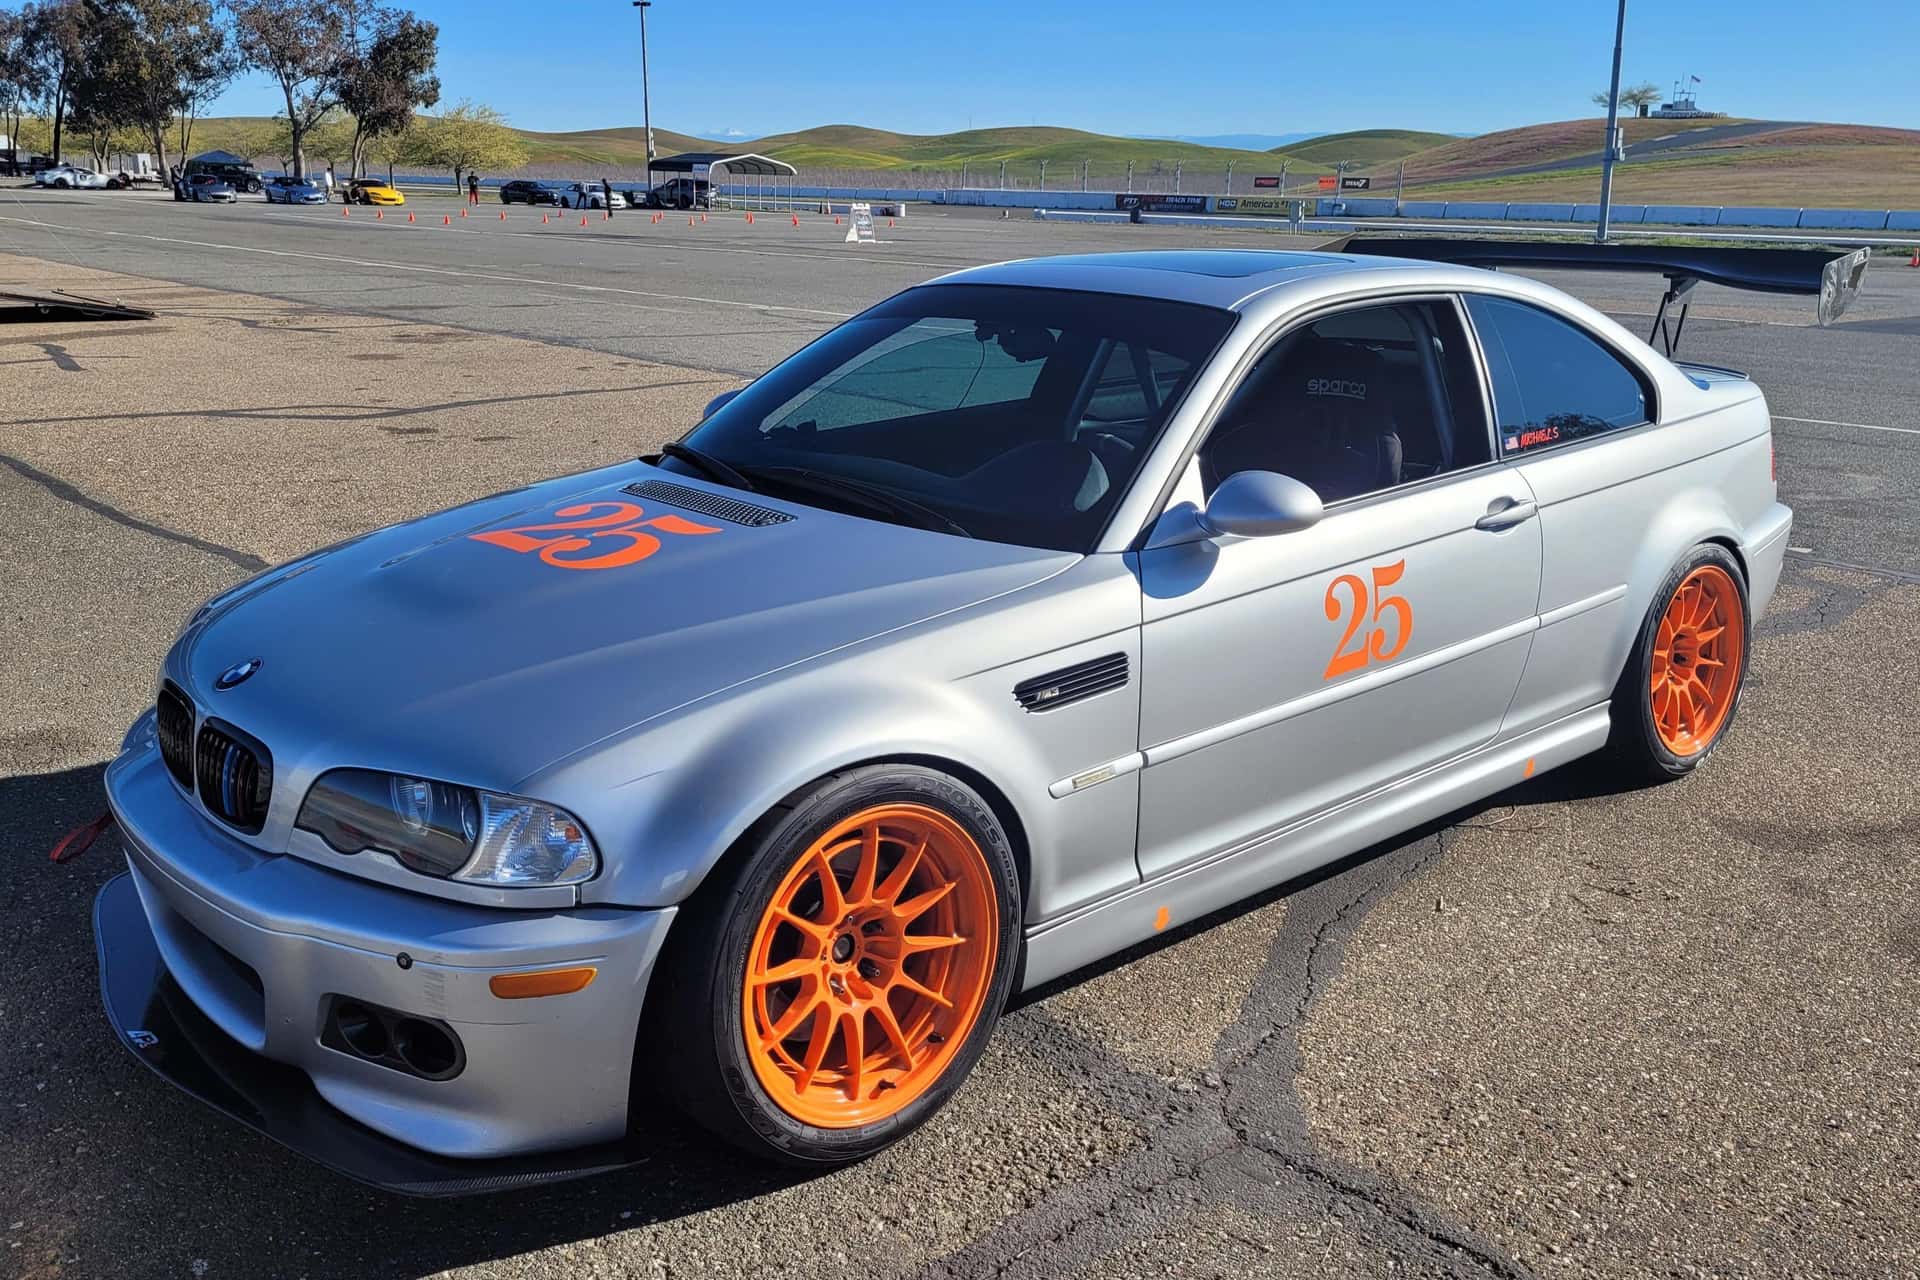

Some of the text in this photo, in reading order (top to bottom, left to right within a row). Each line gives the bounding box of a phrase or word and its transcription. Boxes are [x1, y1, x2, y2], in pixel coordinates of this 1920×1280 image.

[1241, 200, 1279, 209] America's
[1306, 379, 1366, 396] sparco
[467, 502, 723, 569] 25
[1324, 558, 1413, 680] 25
[916, 777, 1001, 846] PROXES
